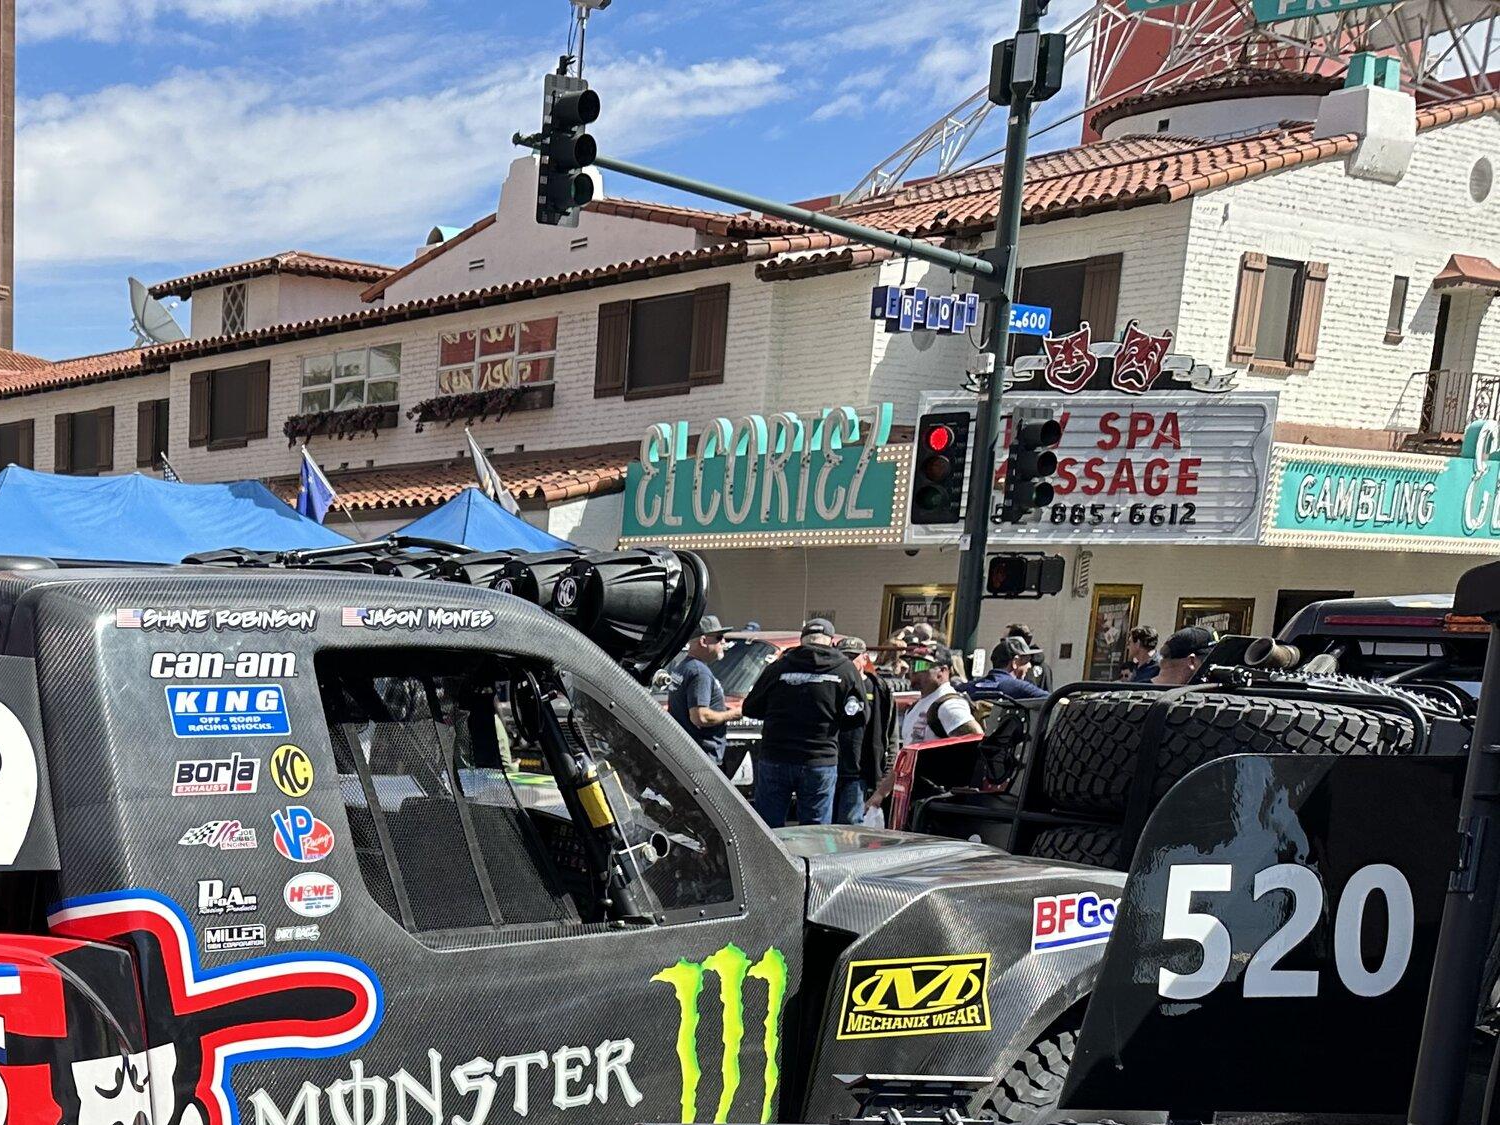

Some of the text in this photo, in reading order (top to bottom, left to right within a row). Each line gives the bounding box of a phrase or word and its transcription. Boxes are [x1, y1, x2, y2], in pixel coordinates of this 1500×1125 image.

[887, 292, 978, 330] FREMONT
[1097, 412, 1182, 450] SPA
[635, 404, 885, 527] EL CORTEZ
[995, 457, 1202, 496] SSAGE
[1297, 474, 1436, 530] GAMBLING
[142, 609, 316, 631] SHANE ROBINSON
[364, 608, 495, 629] JASON MONTES
[174, 690, 279, 712] KING
[175, 784, 228, 794] EXHAUST
[275, 749, 310, 794] KC
[272, 807, 314, 860] VP
[206, 927, 264, 943] MILLER
[1158, 862, 1415, 1001] 520
[846, 1005, 982, 1033] MECHANIX WEAR
